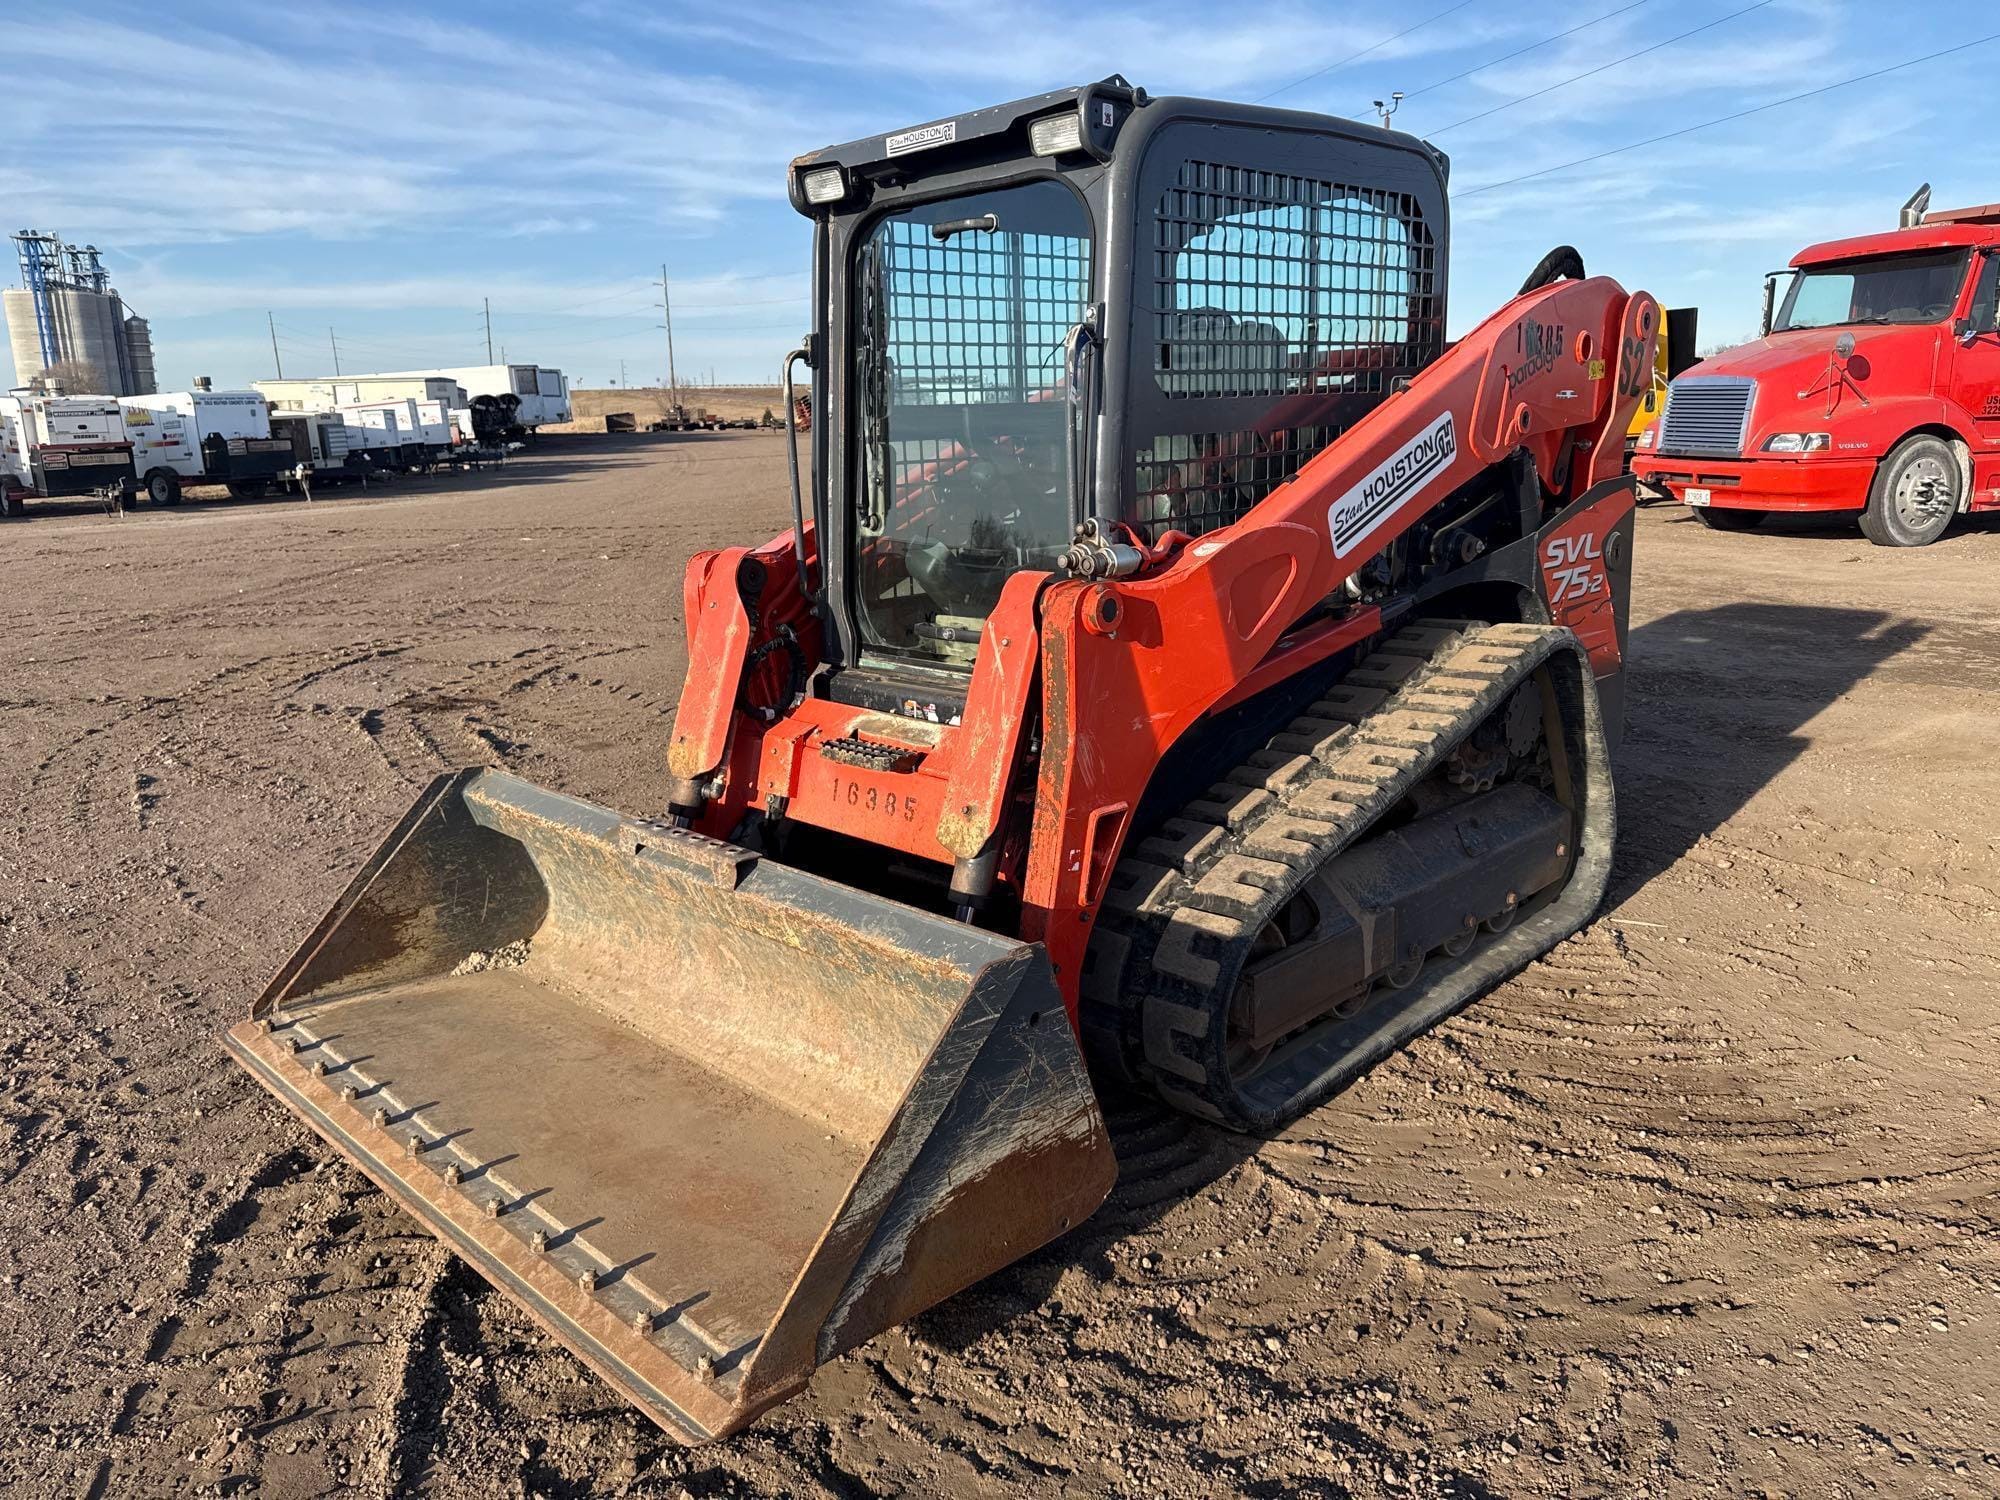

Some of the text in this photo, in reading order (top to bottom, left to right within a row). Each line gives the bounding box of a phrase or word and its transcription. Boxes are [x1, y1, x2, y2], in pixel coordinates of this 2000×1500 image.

[903, 128, 942, 143] HOUSTON
[1517, 322, 1563, 357] 1385
[1619, 336, 1645, 398] S2
[1333, 500, 1365, 535] Stan
[1363, 435, 1436, 508] HOUSTON
[1543, 532, 1601, 569] SVL
[833, 778, 917, 822] 16385
